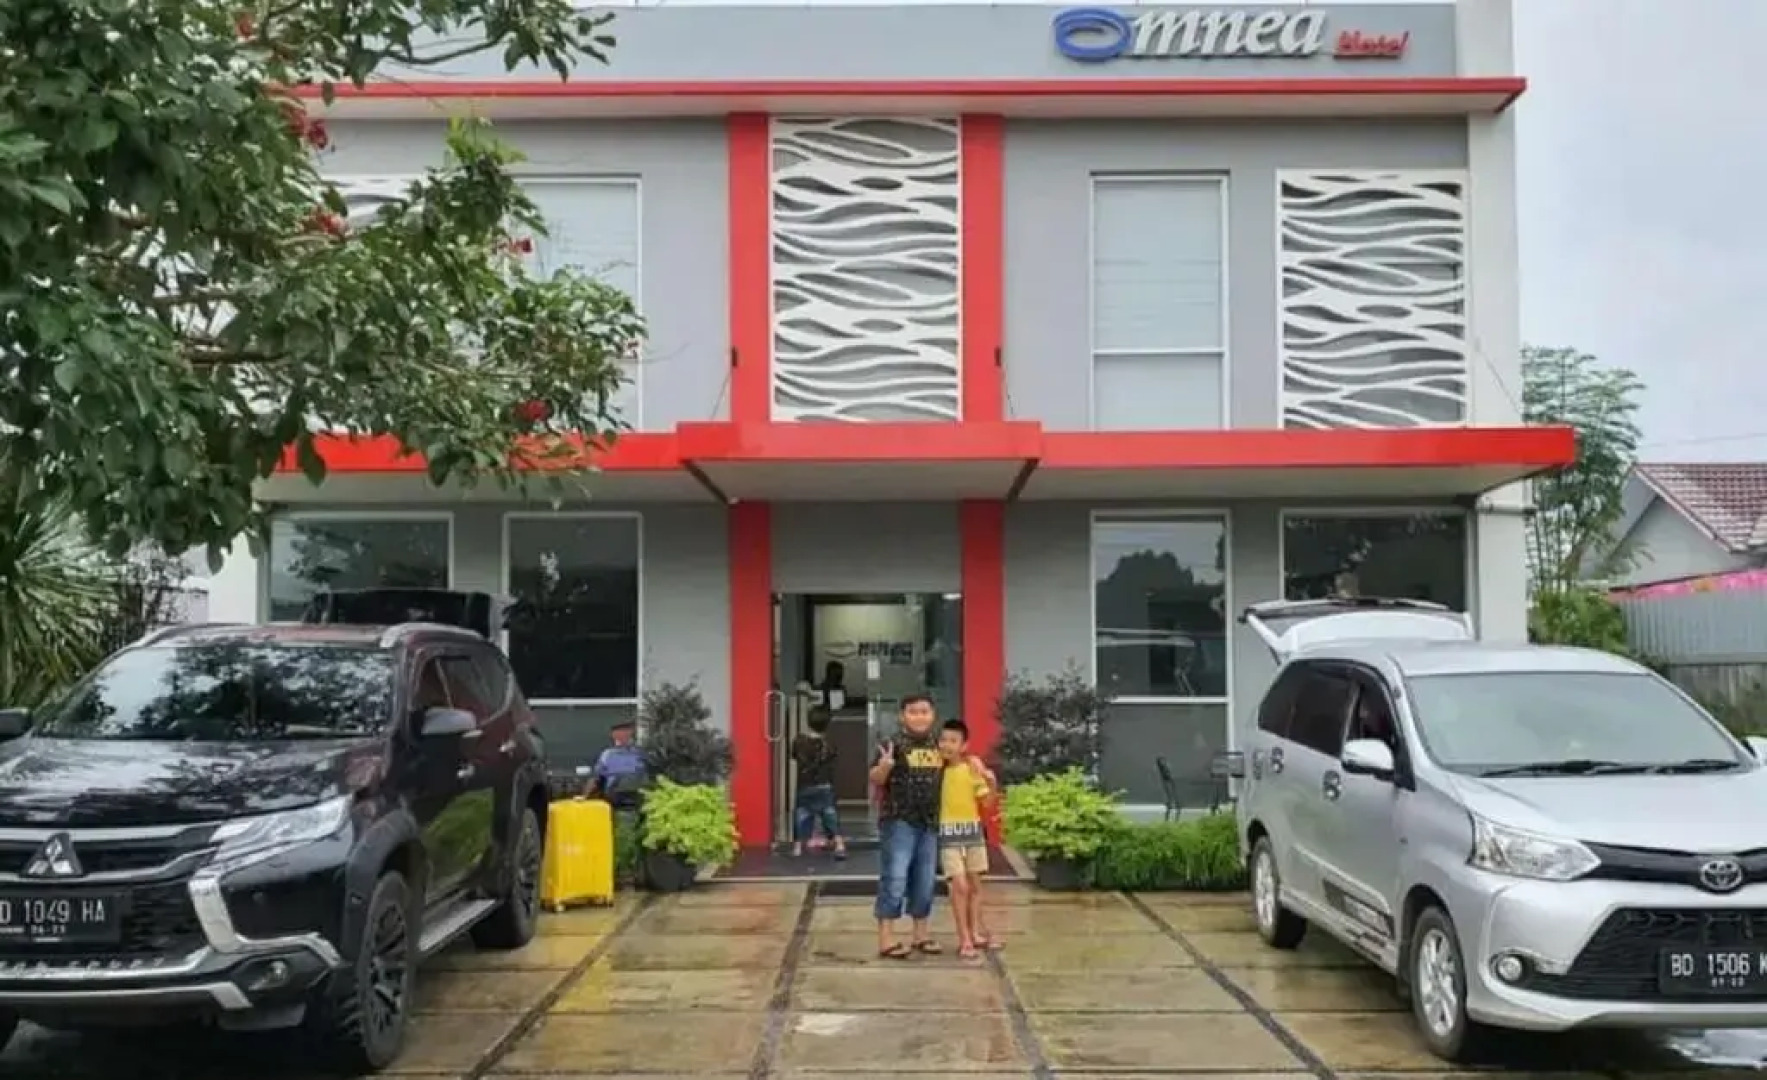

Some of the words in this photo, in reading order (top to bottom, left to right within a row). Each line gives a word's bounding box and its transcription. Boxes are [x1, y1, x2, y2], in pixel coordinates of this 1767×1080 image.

[1053, 7, 1326, 61] Omnea
[24, 899, 70, 924] 1049
[82, 899, 105, 923] HA
[1671, 953, 1694, 977] BD
[1707, 953, 1751, 976] 1506
